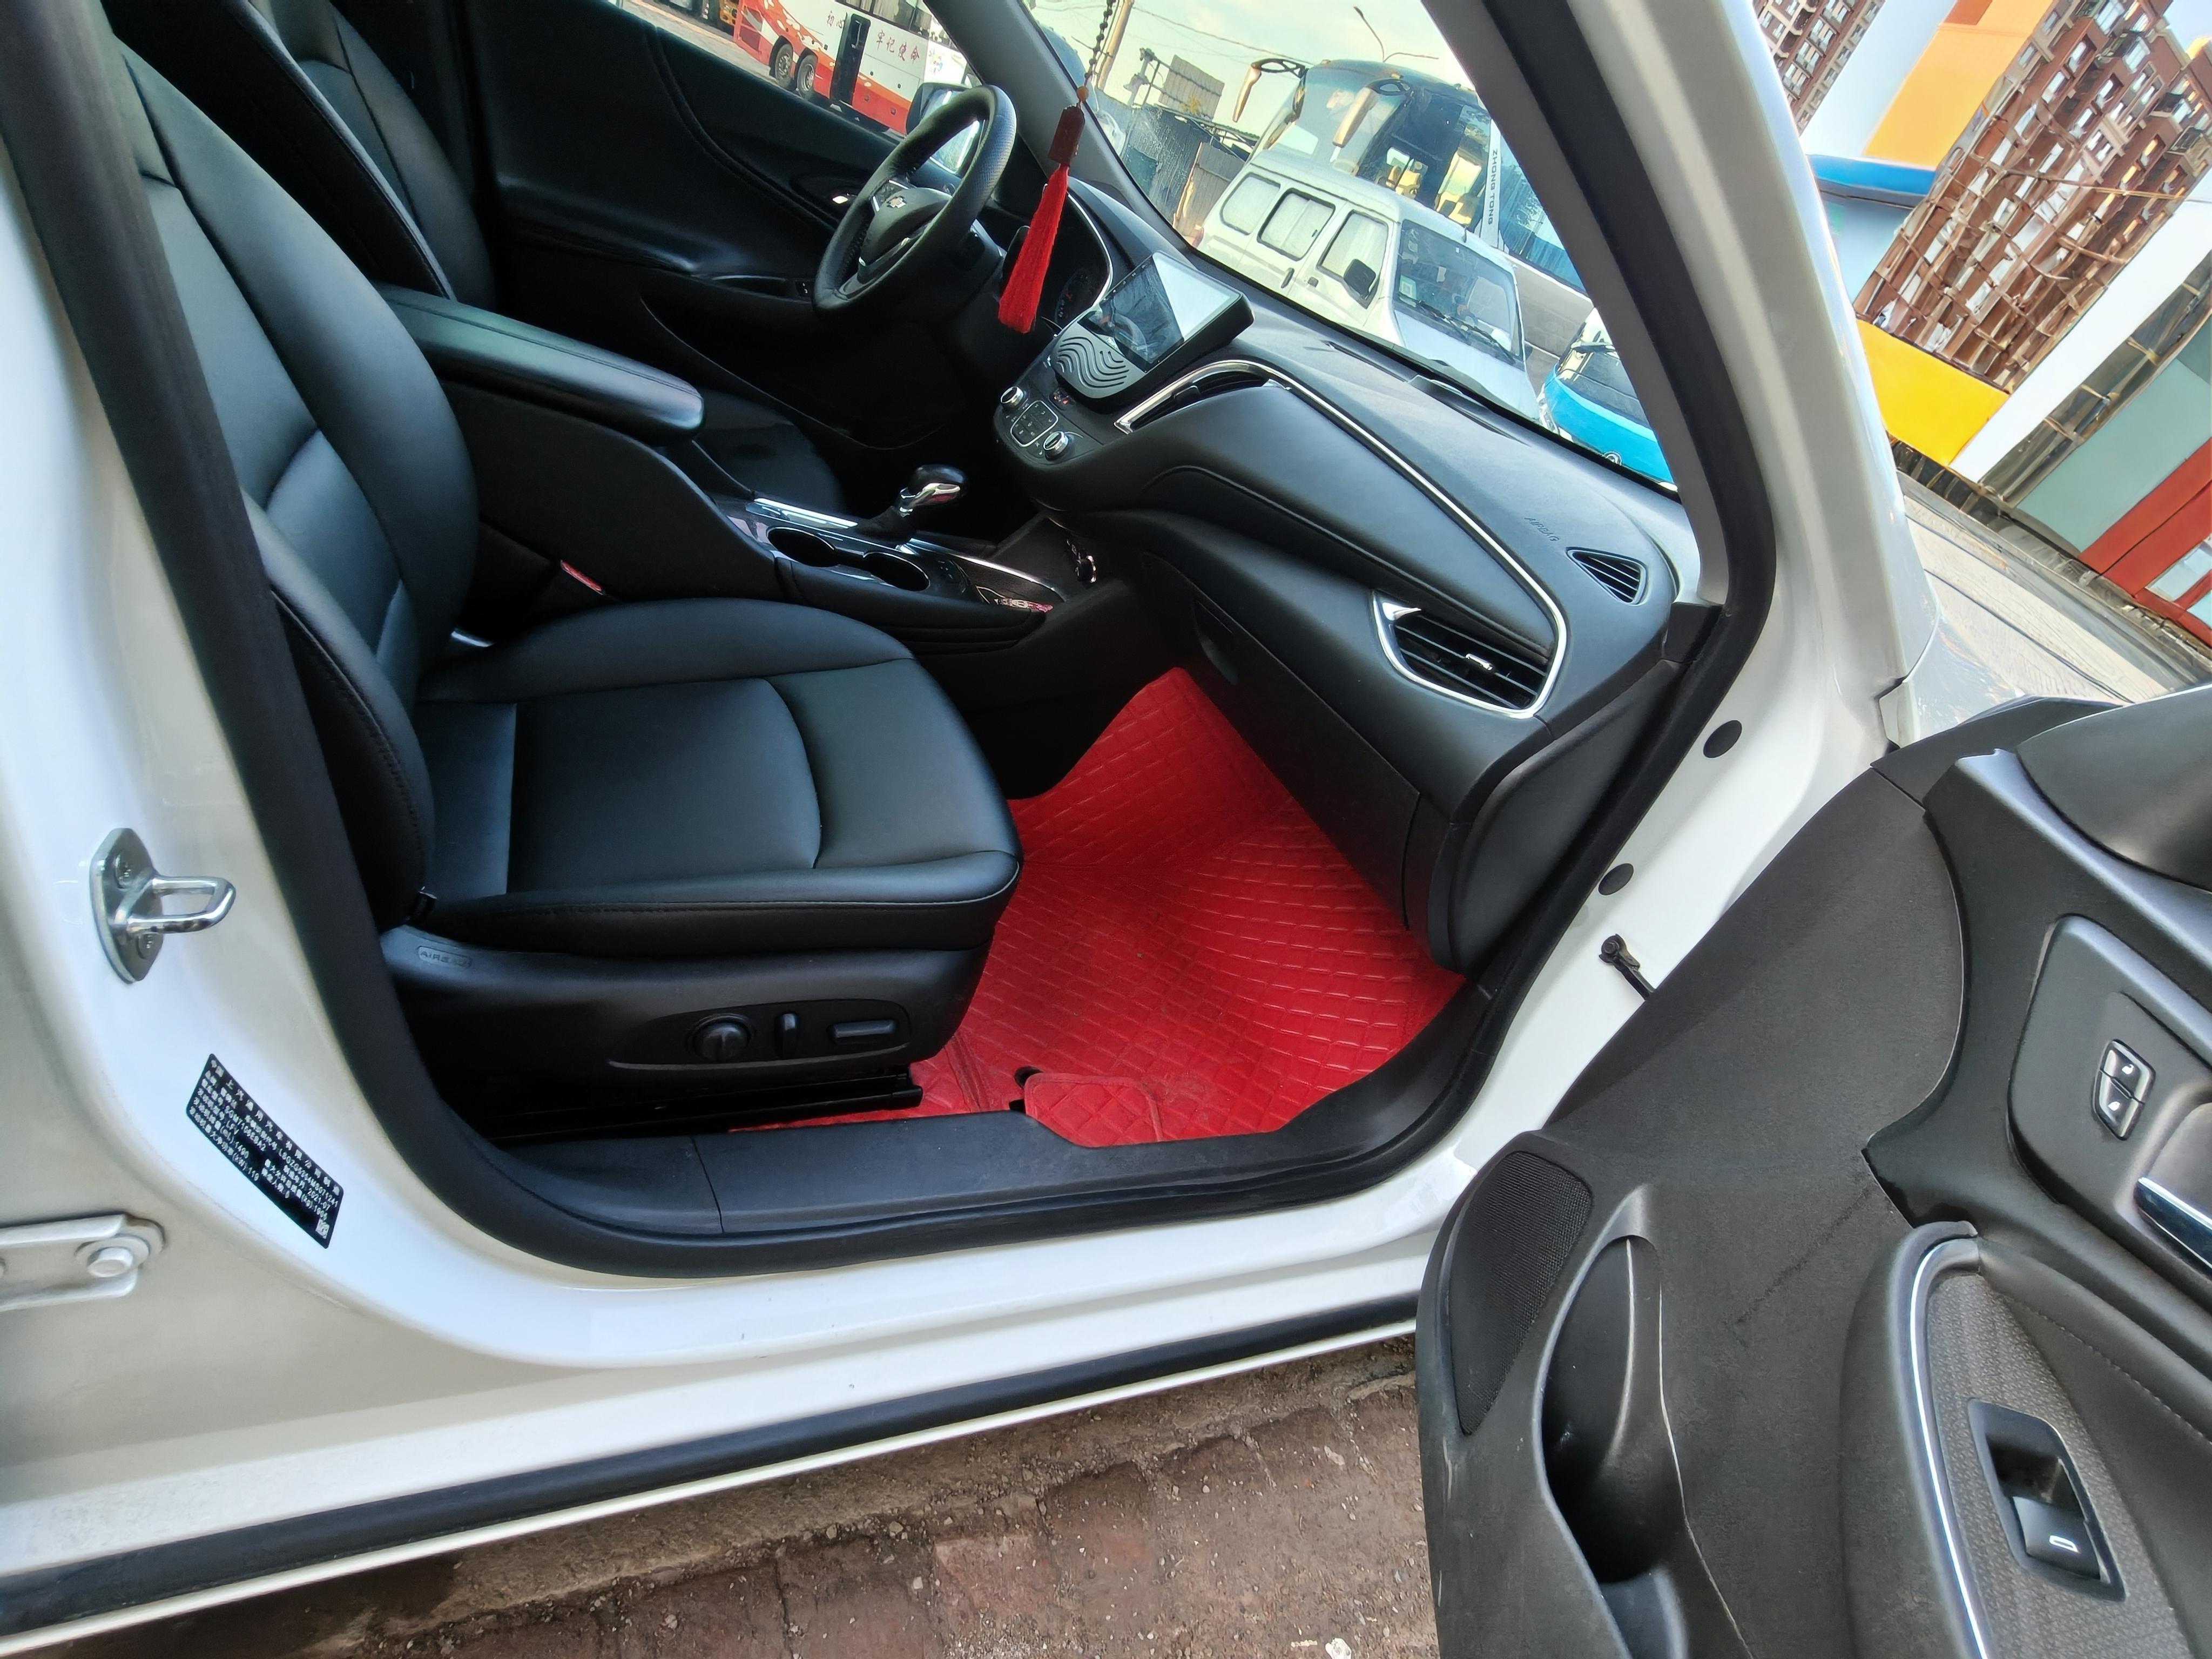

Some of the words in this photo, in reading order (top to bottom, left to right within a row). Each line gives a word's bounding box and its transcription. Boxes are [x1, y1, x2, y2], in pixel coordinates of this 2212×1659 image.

[876, 29, 920, 65] 牢记使命
[1524, 517, 1560, 541] AIRBAG
